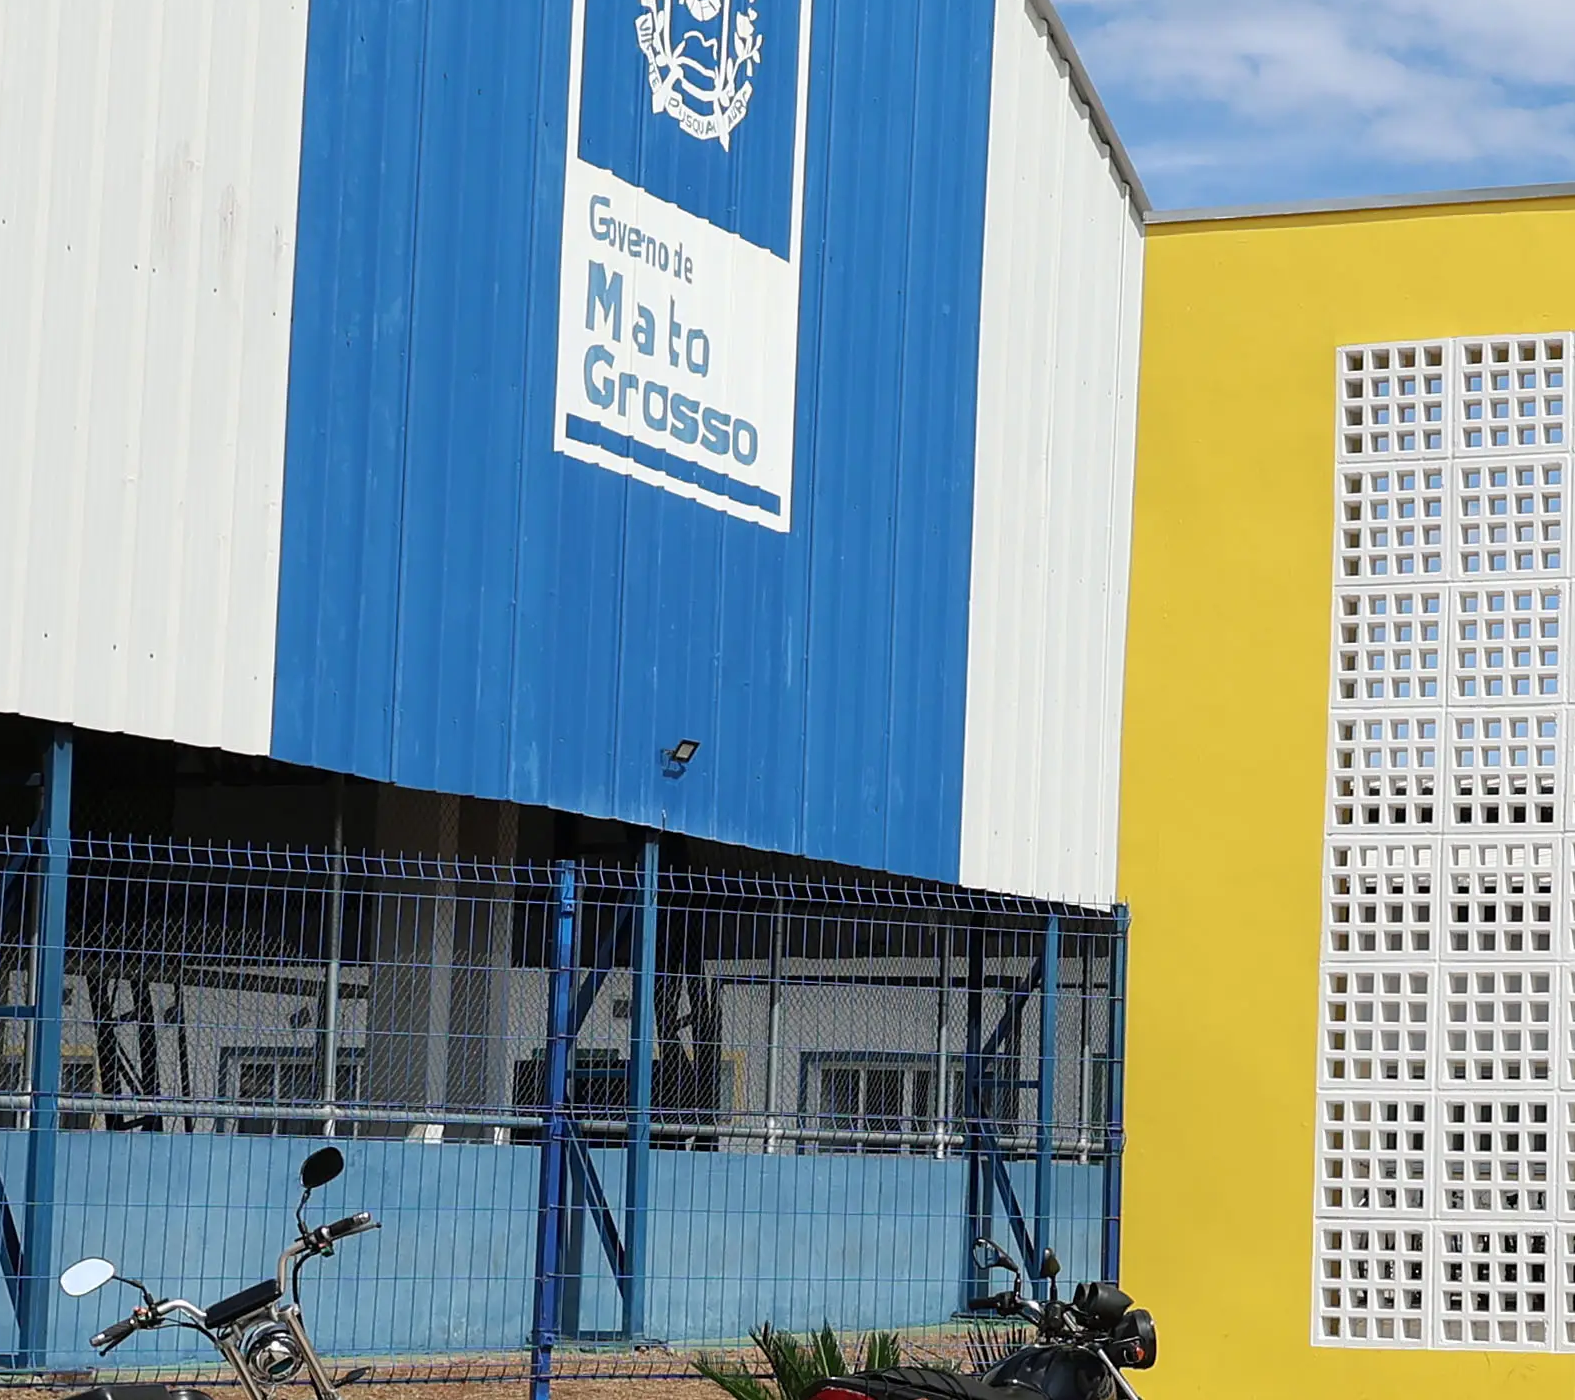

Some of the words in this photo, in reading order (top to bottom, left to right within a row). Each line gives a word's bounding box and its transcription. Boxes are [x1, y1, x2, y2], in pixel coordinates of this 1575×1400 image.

[589, 194, 669, 272] Governo
[673, 242, 693, 284] de
[585, 259, 710, 378] Mato
[583, 345, 758, 466] Grosso
